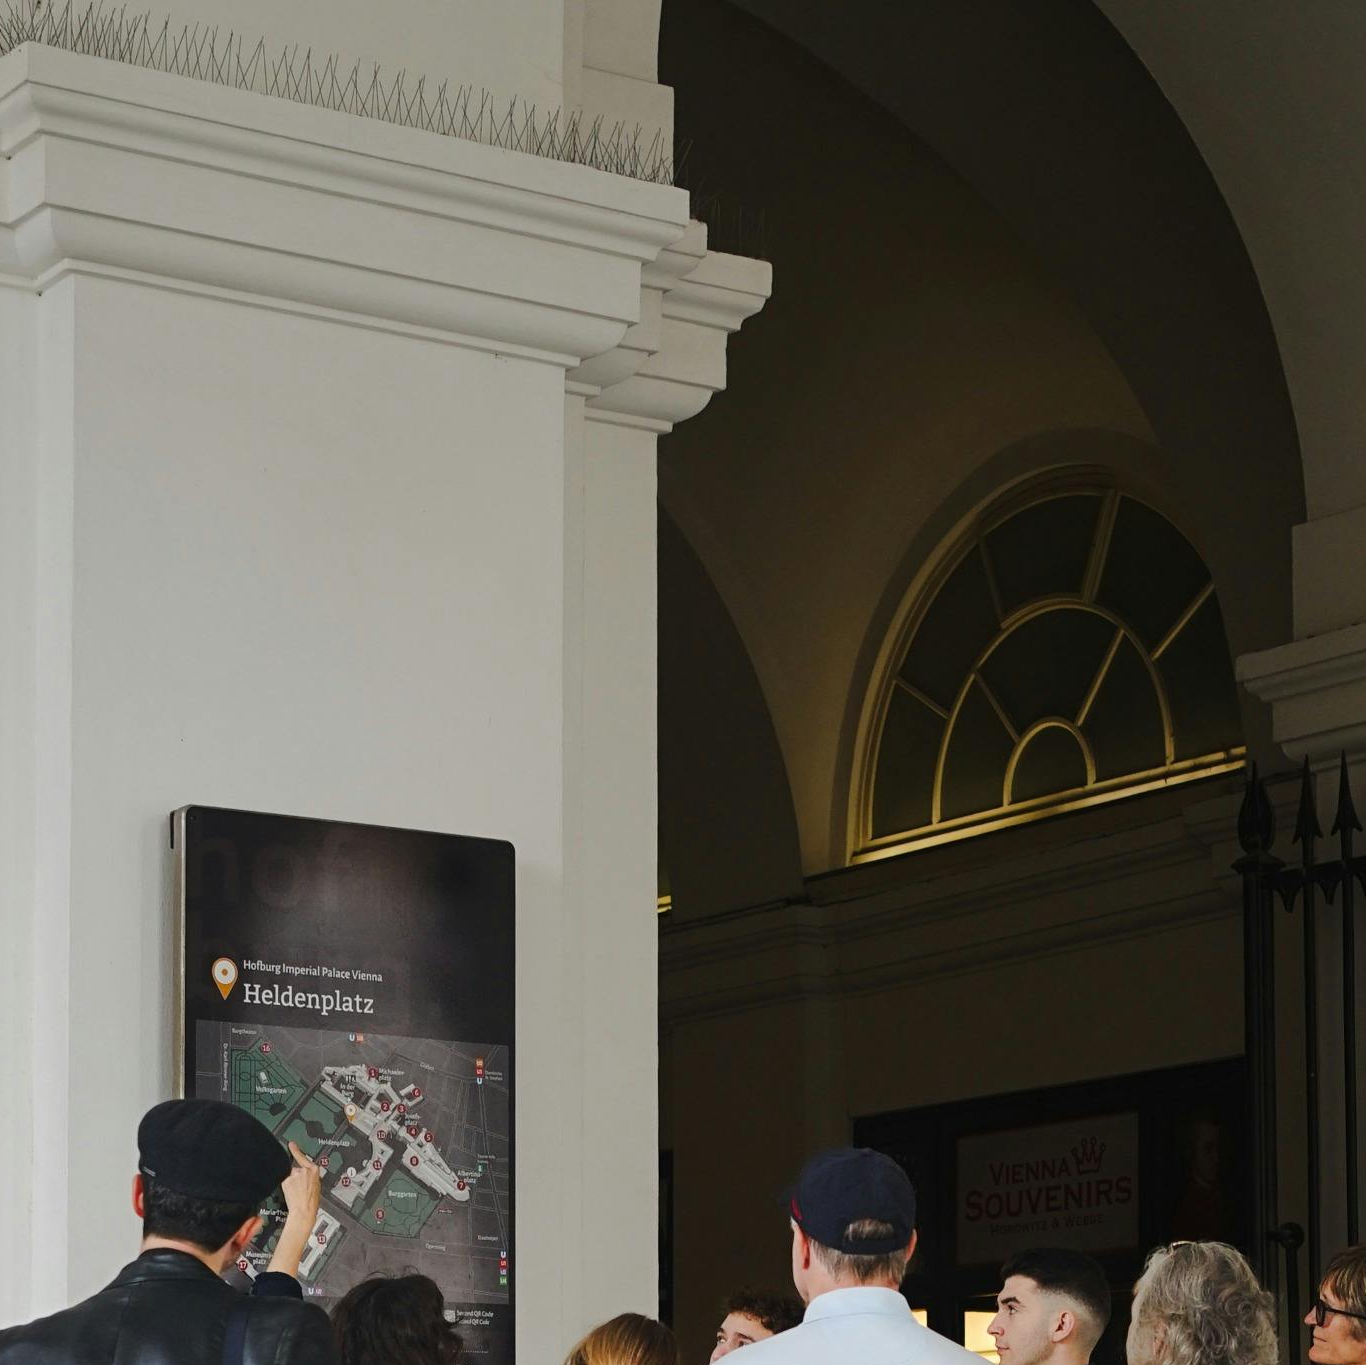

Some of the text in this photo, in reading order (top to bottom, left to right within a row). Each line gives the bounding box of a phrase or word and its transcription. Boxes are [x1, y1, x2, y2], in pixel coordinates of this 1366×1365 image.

[243, 959, 383, 982] Hofburg Imperial Palace Vienna
[243, 983, 374, 1016] Heldenplatz
[988, 1157, 1071, 1186] VIENNA
[965, 1175, 1132, 1222] SOUVENIRS
